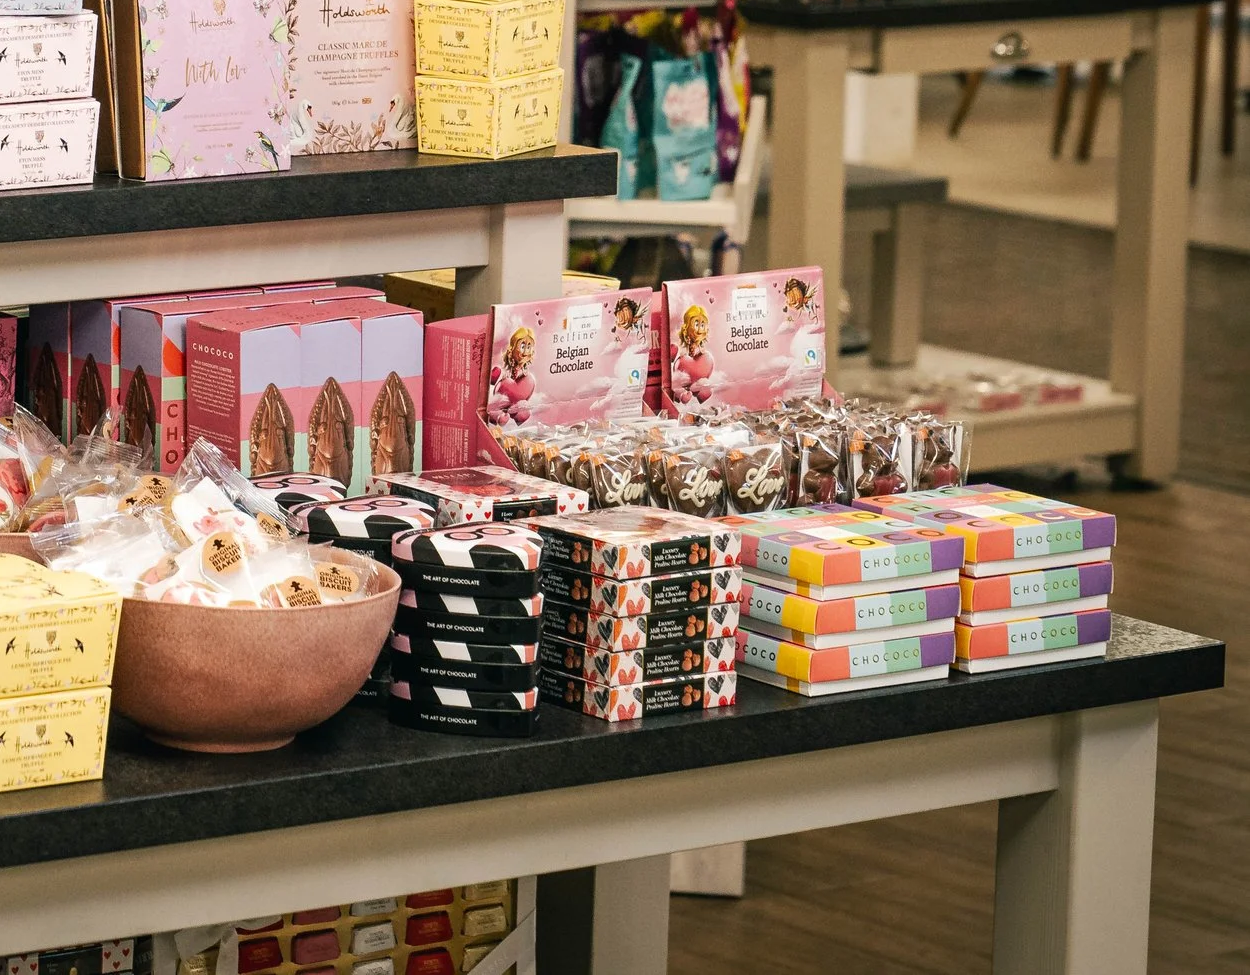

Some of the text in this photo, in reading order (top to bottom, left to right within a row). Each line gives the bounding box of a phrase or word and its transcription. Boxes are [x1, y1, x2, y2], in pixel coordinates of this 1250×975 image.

[190, 10, 236, 34] Holdsworth
[318, 40, 388, 51] CLASSIC MARC DE
[308, 50, 399, 62] CHAMPAGNE TRUFFLES
[186, 56, 219, 88] With
[552, 332, 594, 344] Belfine
[730, 324, 764, 339] Belgian
[192, 342, 234, 360] CHOCOCO
[726, 338, 769, 352] Chocolate
[556, 346, 589, 360] Belgian
[550, 360, 594, 374] Chocolate
[1016, 530, 1083, 547] CHOCOCO
[208, 542, 240, 562] ORIGINAL
[212, 546, 242, 568] BISCUIT
[216, 554, 242, 573] BAKER
[863, 551, 930, 569] CHOCOCO
[319, 571, 352, 582] ORIGINAL
[320, 576, 351, 587] BISCUIT
[450, 577, 480, 586] CHOCOLATE
[320, 581, 352, 593] BAKERS
[1013, 578, 1079, 596] CHOCOCO
[286, 588, 316, 603] ORIGINAL
[290, 594, 318, 608] BISCUIT
[857, 601, 926, 618] CHOCOCO
[436, 622, 446, 630] ART
[454, 624, 484, 633] CHOCOLATE
[1010, 626, 1077, 643] CHOCOCO
[852, 648, 920, 666] CHOCOCO
[420, 666, 429, 674] THE
[446, 670, 478, 679] CHOCOLATE
[430, 714, 439, 722] ART
[447, 716, 478, 726] CHOCOLATE
